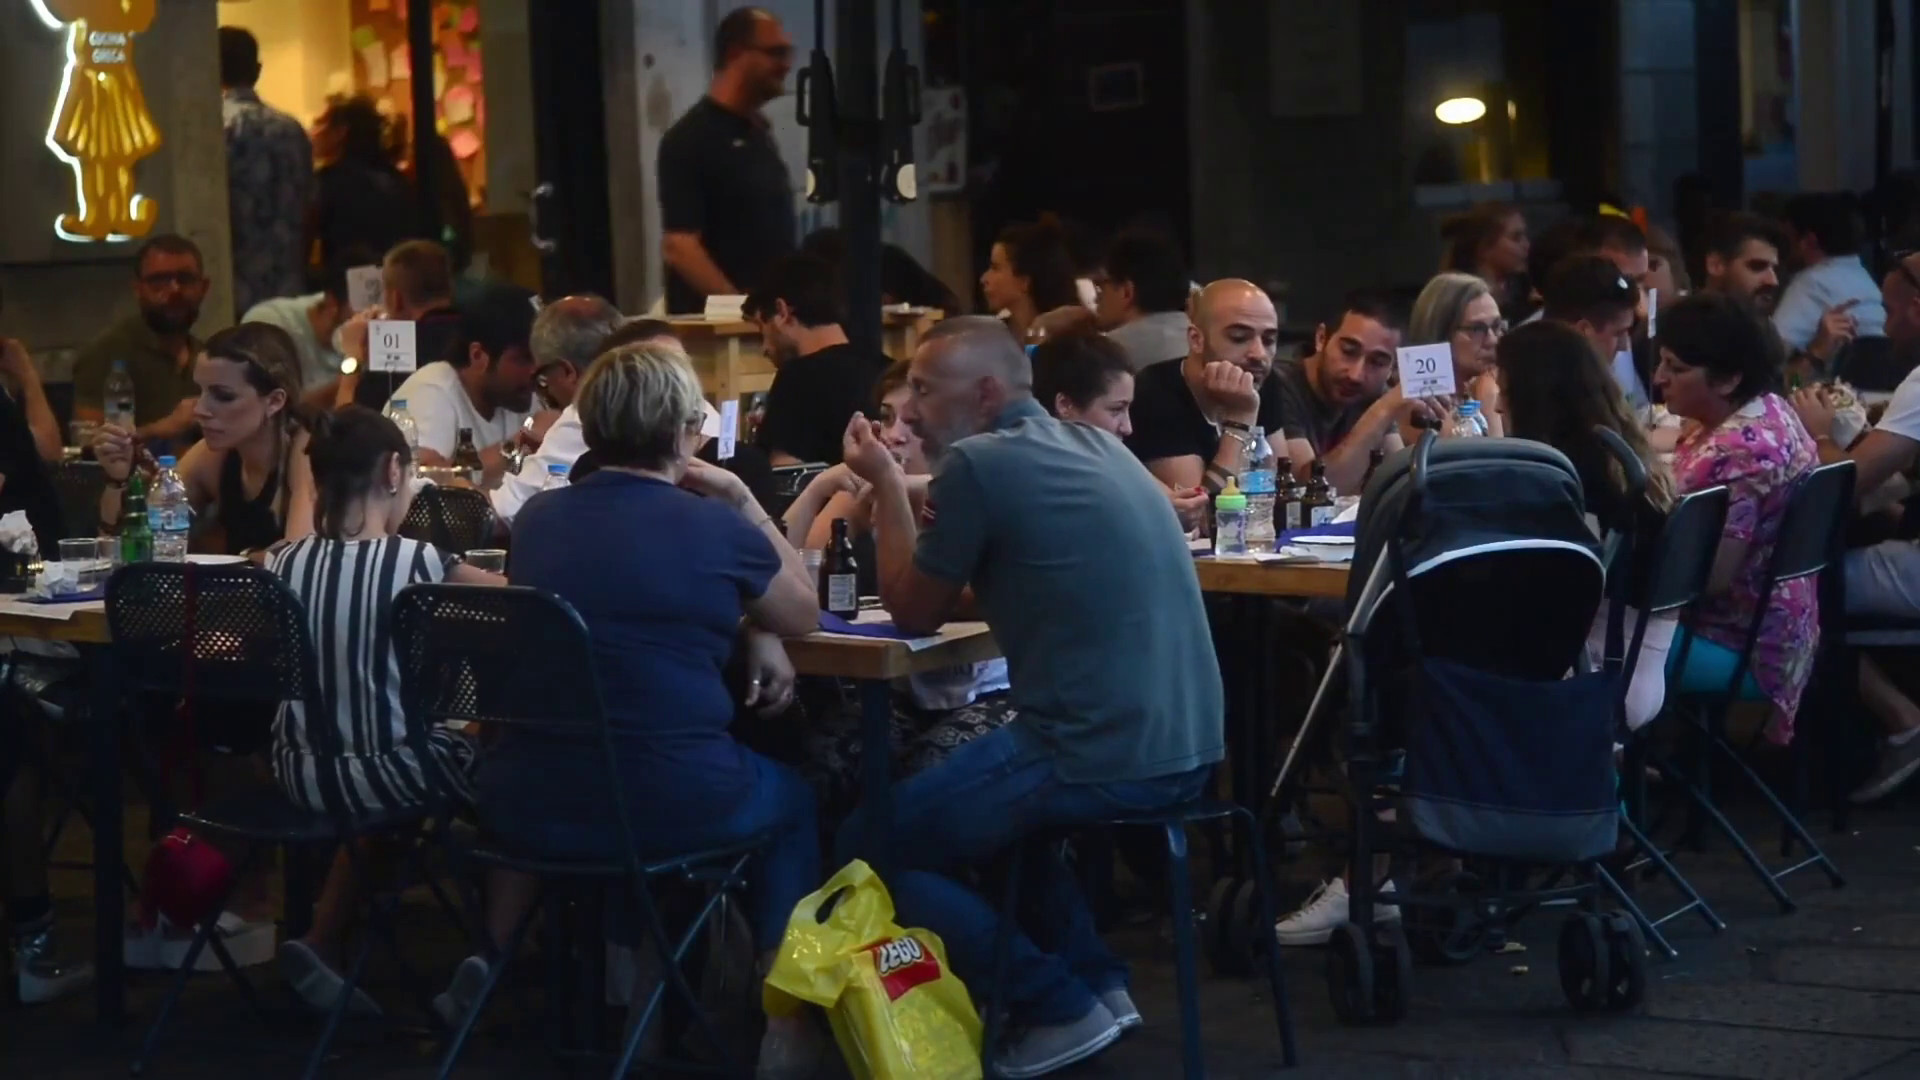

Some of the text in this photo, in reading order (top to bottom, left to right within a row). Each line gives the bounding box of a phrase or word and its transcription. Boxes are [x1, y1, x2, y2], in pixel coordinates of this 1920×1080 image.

[383, 333, 400, 349] 01
[1415, 357, 1437, 375] 20
[880, 937, 923, 974] LEGO
